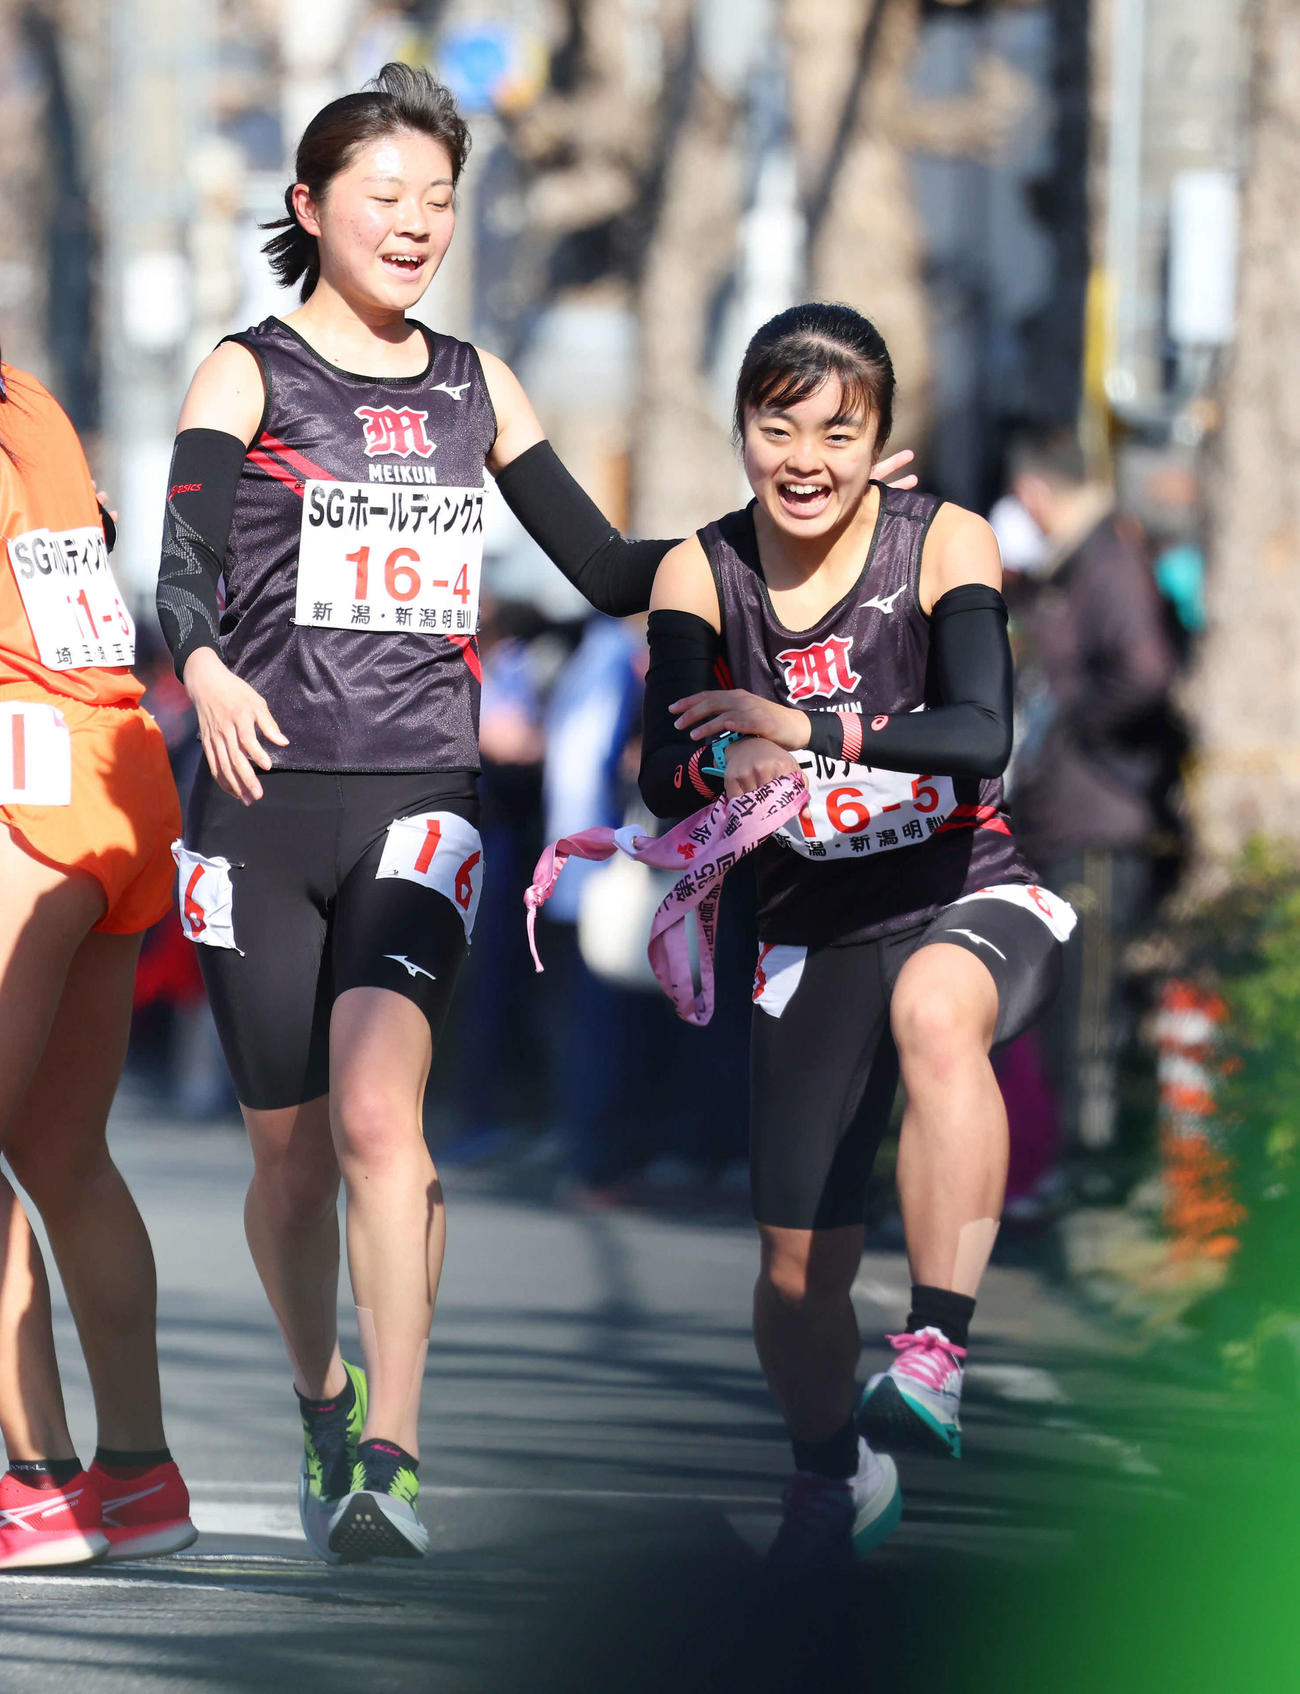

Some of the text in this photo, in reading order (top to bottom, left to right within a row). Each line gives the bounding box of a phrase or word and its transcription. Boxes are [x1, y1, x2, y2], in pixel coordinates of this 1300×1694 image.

[368, 464, 437, 484] MEIKUN
[308, 486, 484, 536] SGホールディングス
[345, 546, 471, 605] 16-4
[414, 819, 481, 911] 16
